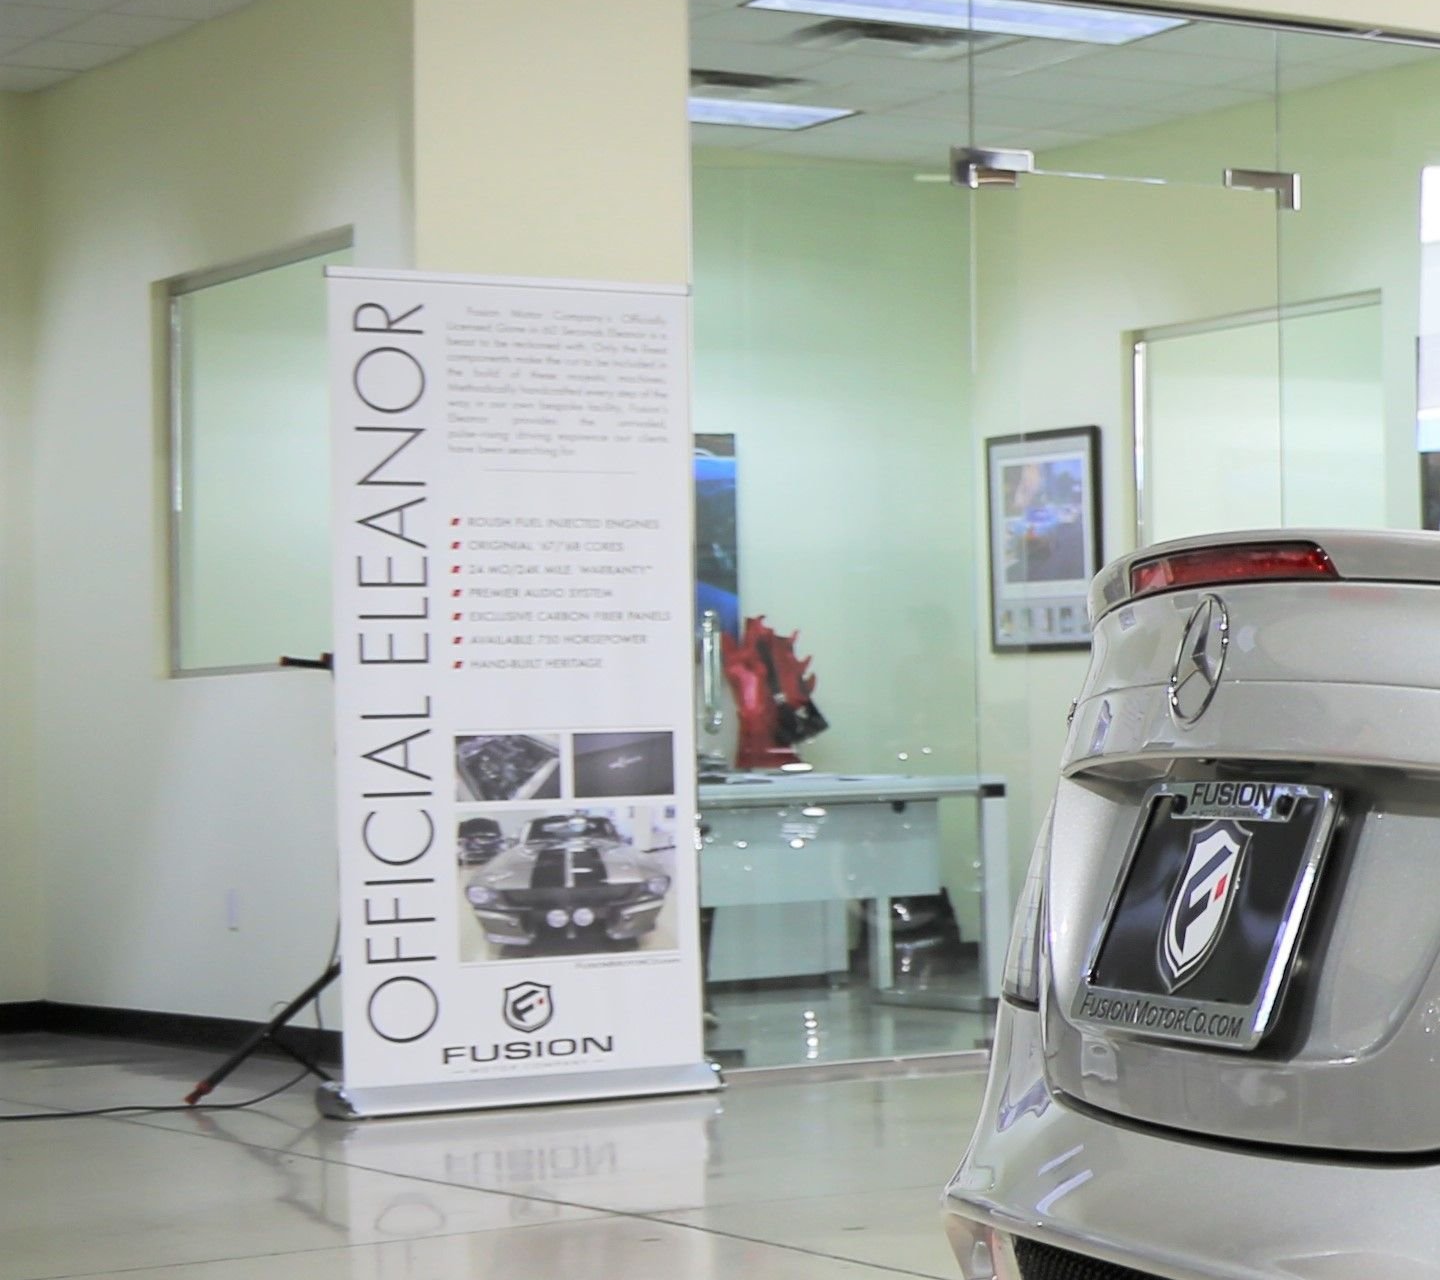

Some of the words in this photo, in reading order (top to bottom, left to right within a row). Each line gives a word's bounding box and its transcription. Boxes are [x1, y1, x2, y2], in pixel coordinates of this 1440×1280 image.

[353, 302, 429, 664] ELEANOR
[360, 695, 439, 1044] OFFICIAL
[1190, 782, 1277, 808] FUSION
[442, 1035, 613, 1065] FUSION
